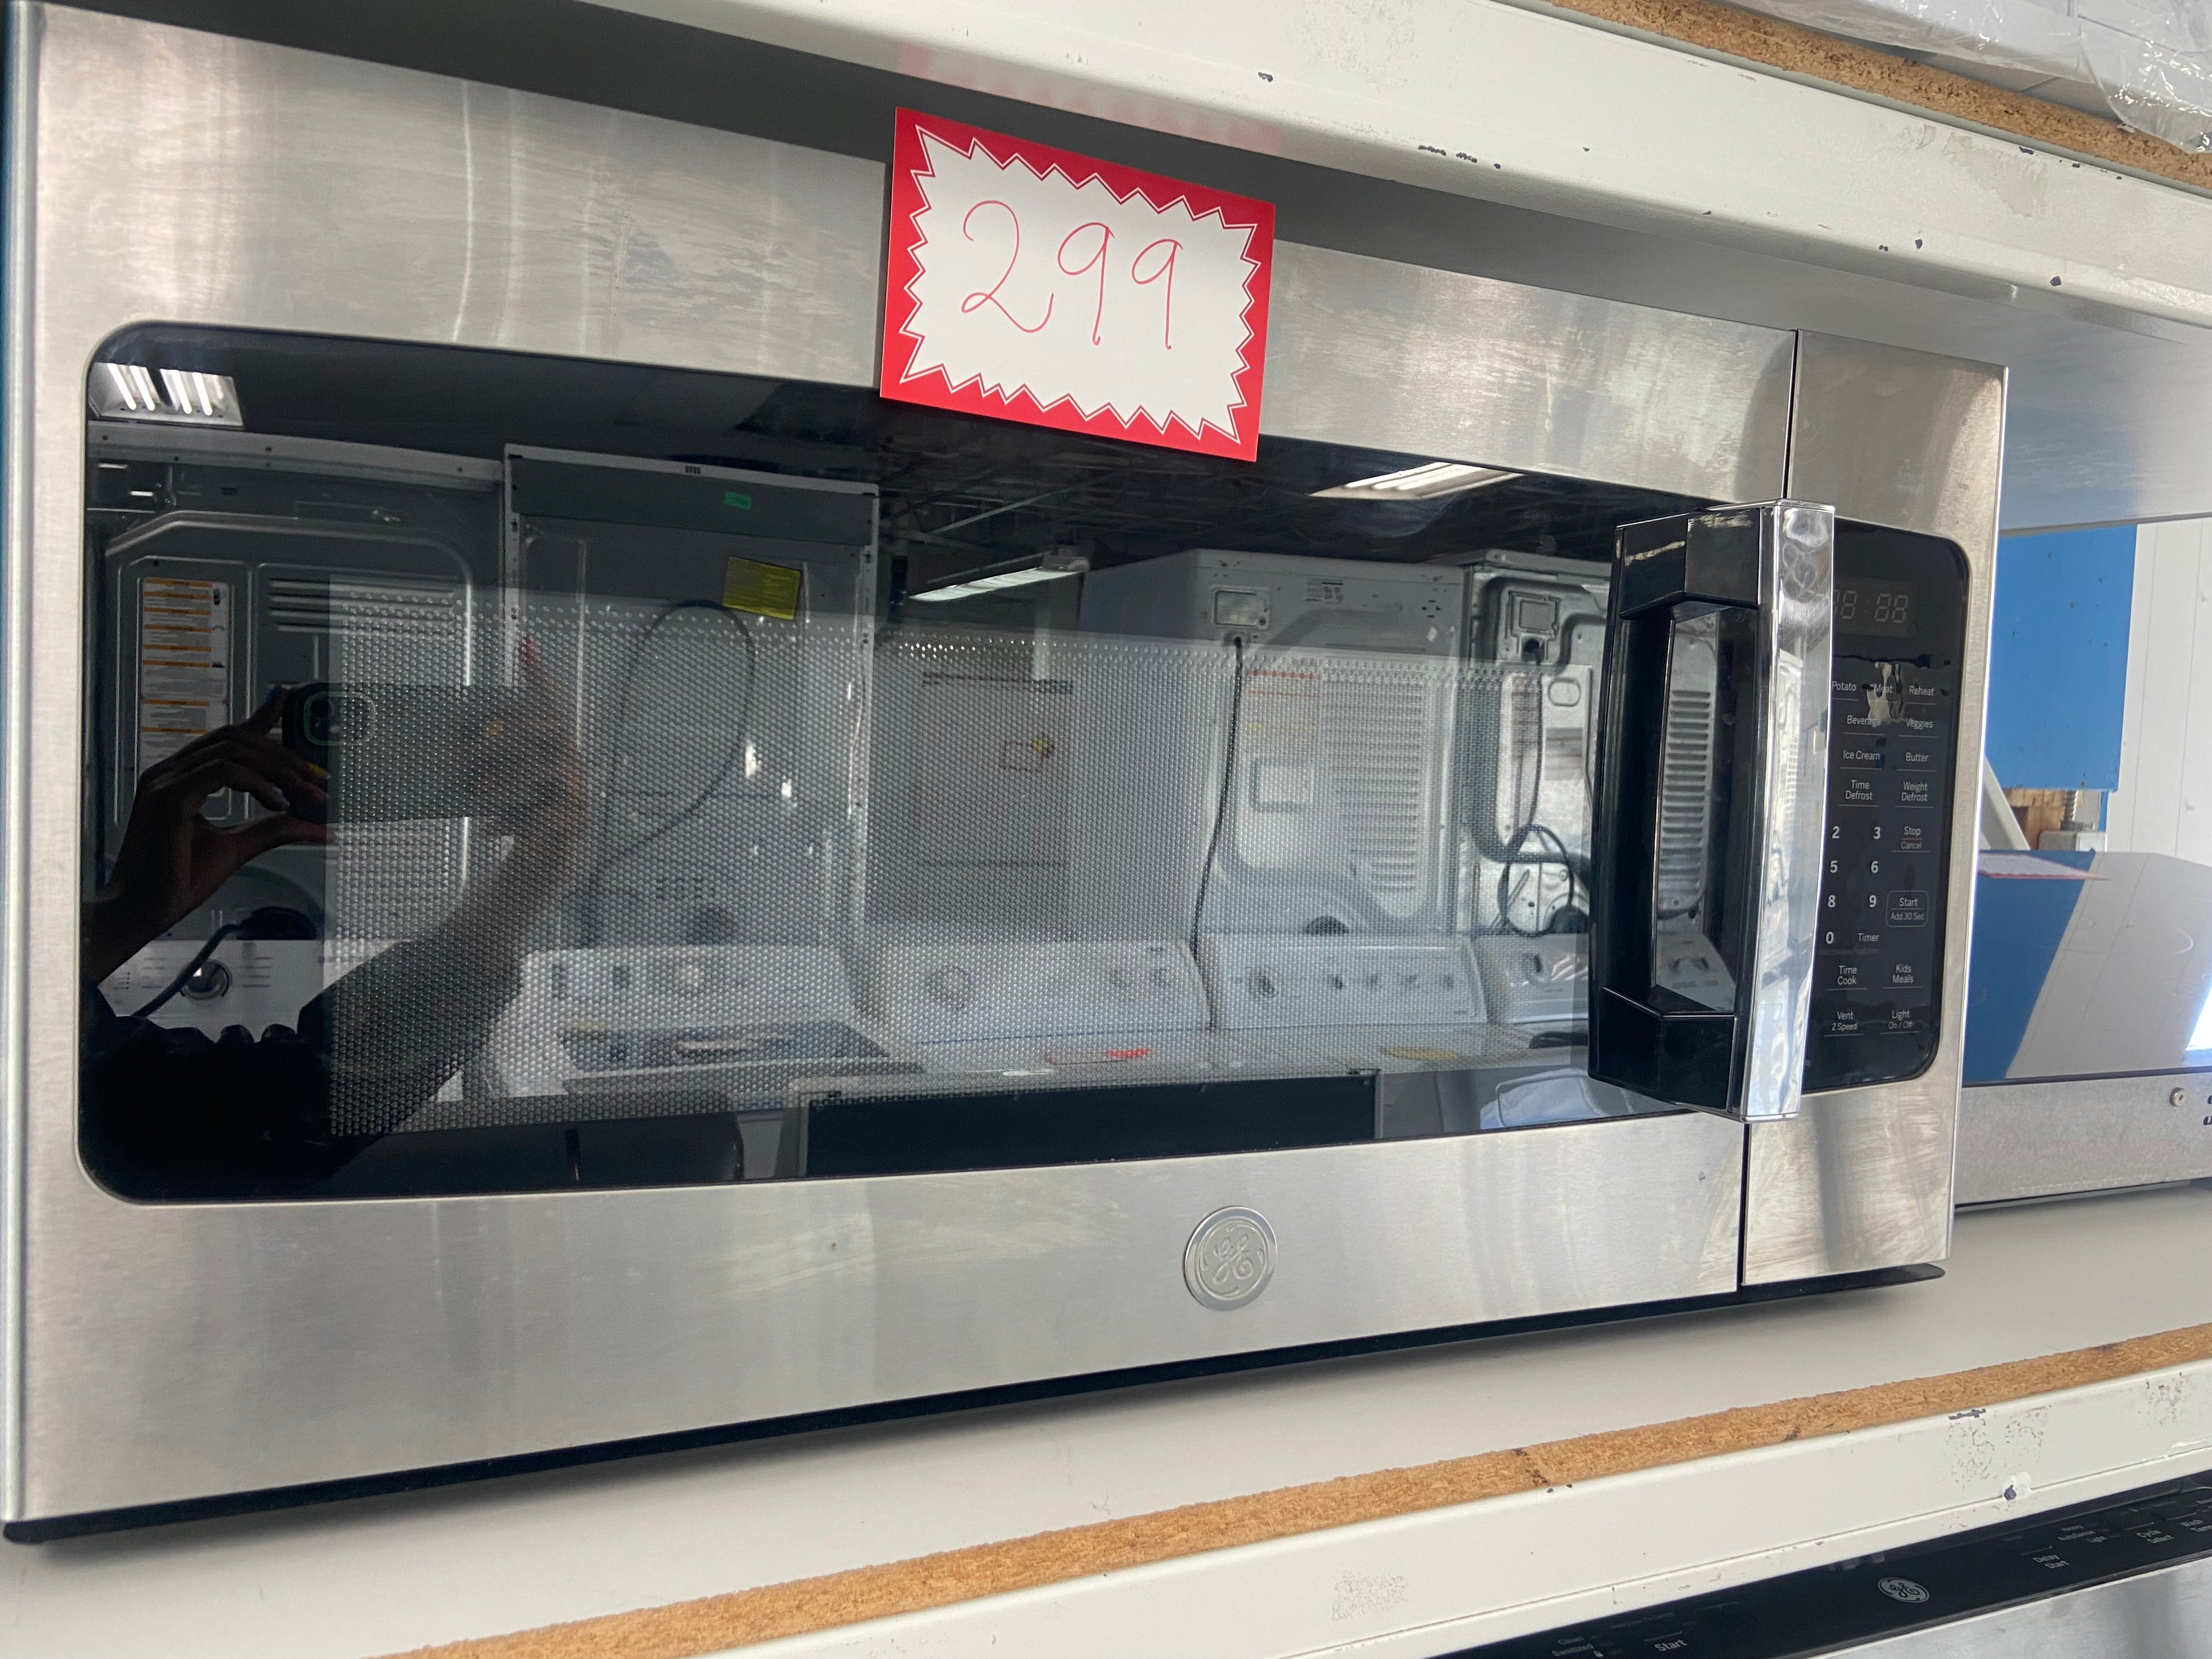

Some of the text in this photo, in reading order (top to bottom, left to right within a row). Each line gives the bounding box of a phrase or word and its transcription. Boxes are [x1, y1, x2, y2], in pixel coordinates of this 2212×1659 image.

[961, 199, 1184, 350] 299
[1832, 681, 1857, 691] Potato
[1874, 683, 1893, 694] Meat
[1908, 685, 1935, 696] Reheat
[1847, 714, 1881, 727] Beverage
[1906, 718, 1934, 729] Veggies
[1843, 750, 1881, 760] Ice Cream
[1905, 752, 1929, 762] Butter
[1851, 779, 1870, 790] Time
[1903, 781, 1928, 793] Weight
[1845, 790, 1873, 800] Defrost
[1901, 792, 1928, 802] Defrost
[1832, 825, 1840, 839] 2
[1873, 826, 1881, 839] 3
[1903, 826, 1922, 836] Stop
[1900, 841, 1922, 849] Cancel
[1830, 860, 1838, 873] 5
[1870, 861, 1878, 873] 6
[1827, 895, 1836, 908] 8
[1869, 895, 1877, 908] 9
[1899, 897, 1918, 907] Start
[1889, 912, 1925, 921] Add 30 Sec
[1825, 931, 1834, 945] 0
[1858, 932, 1880, 942] Timer
[1839, 965, 1858, 975] Time
[1895, 964, 1912, 974] Kids
[1837, 975, 1857, 985] Cook
[1892, 975, 1914, 983] Meals
[1837, 1010, 1854, 1020] Vent
[1892, 1010, 1911, 1021] Light
[1831, 1022, 1858, 1032] 2 Speed
[1888, 1021, 1898, 1029] On
[1903, 1020, 1912, 1029] Off
[2032, 1554, 2059, 1563] Delay
[2044, 1559, 2070, 1569] Start
[1654, 1638, 1687, 1652] Start
